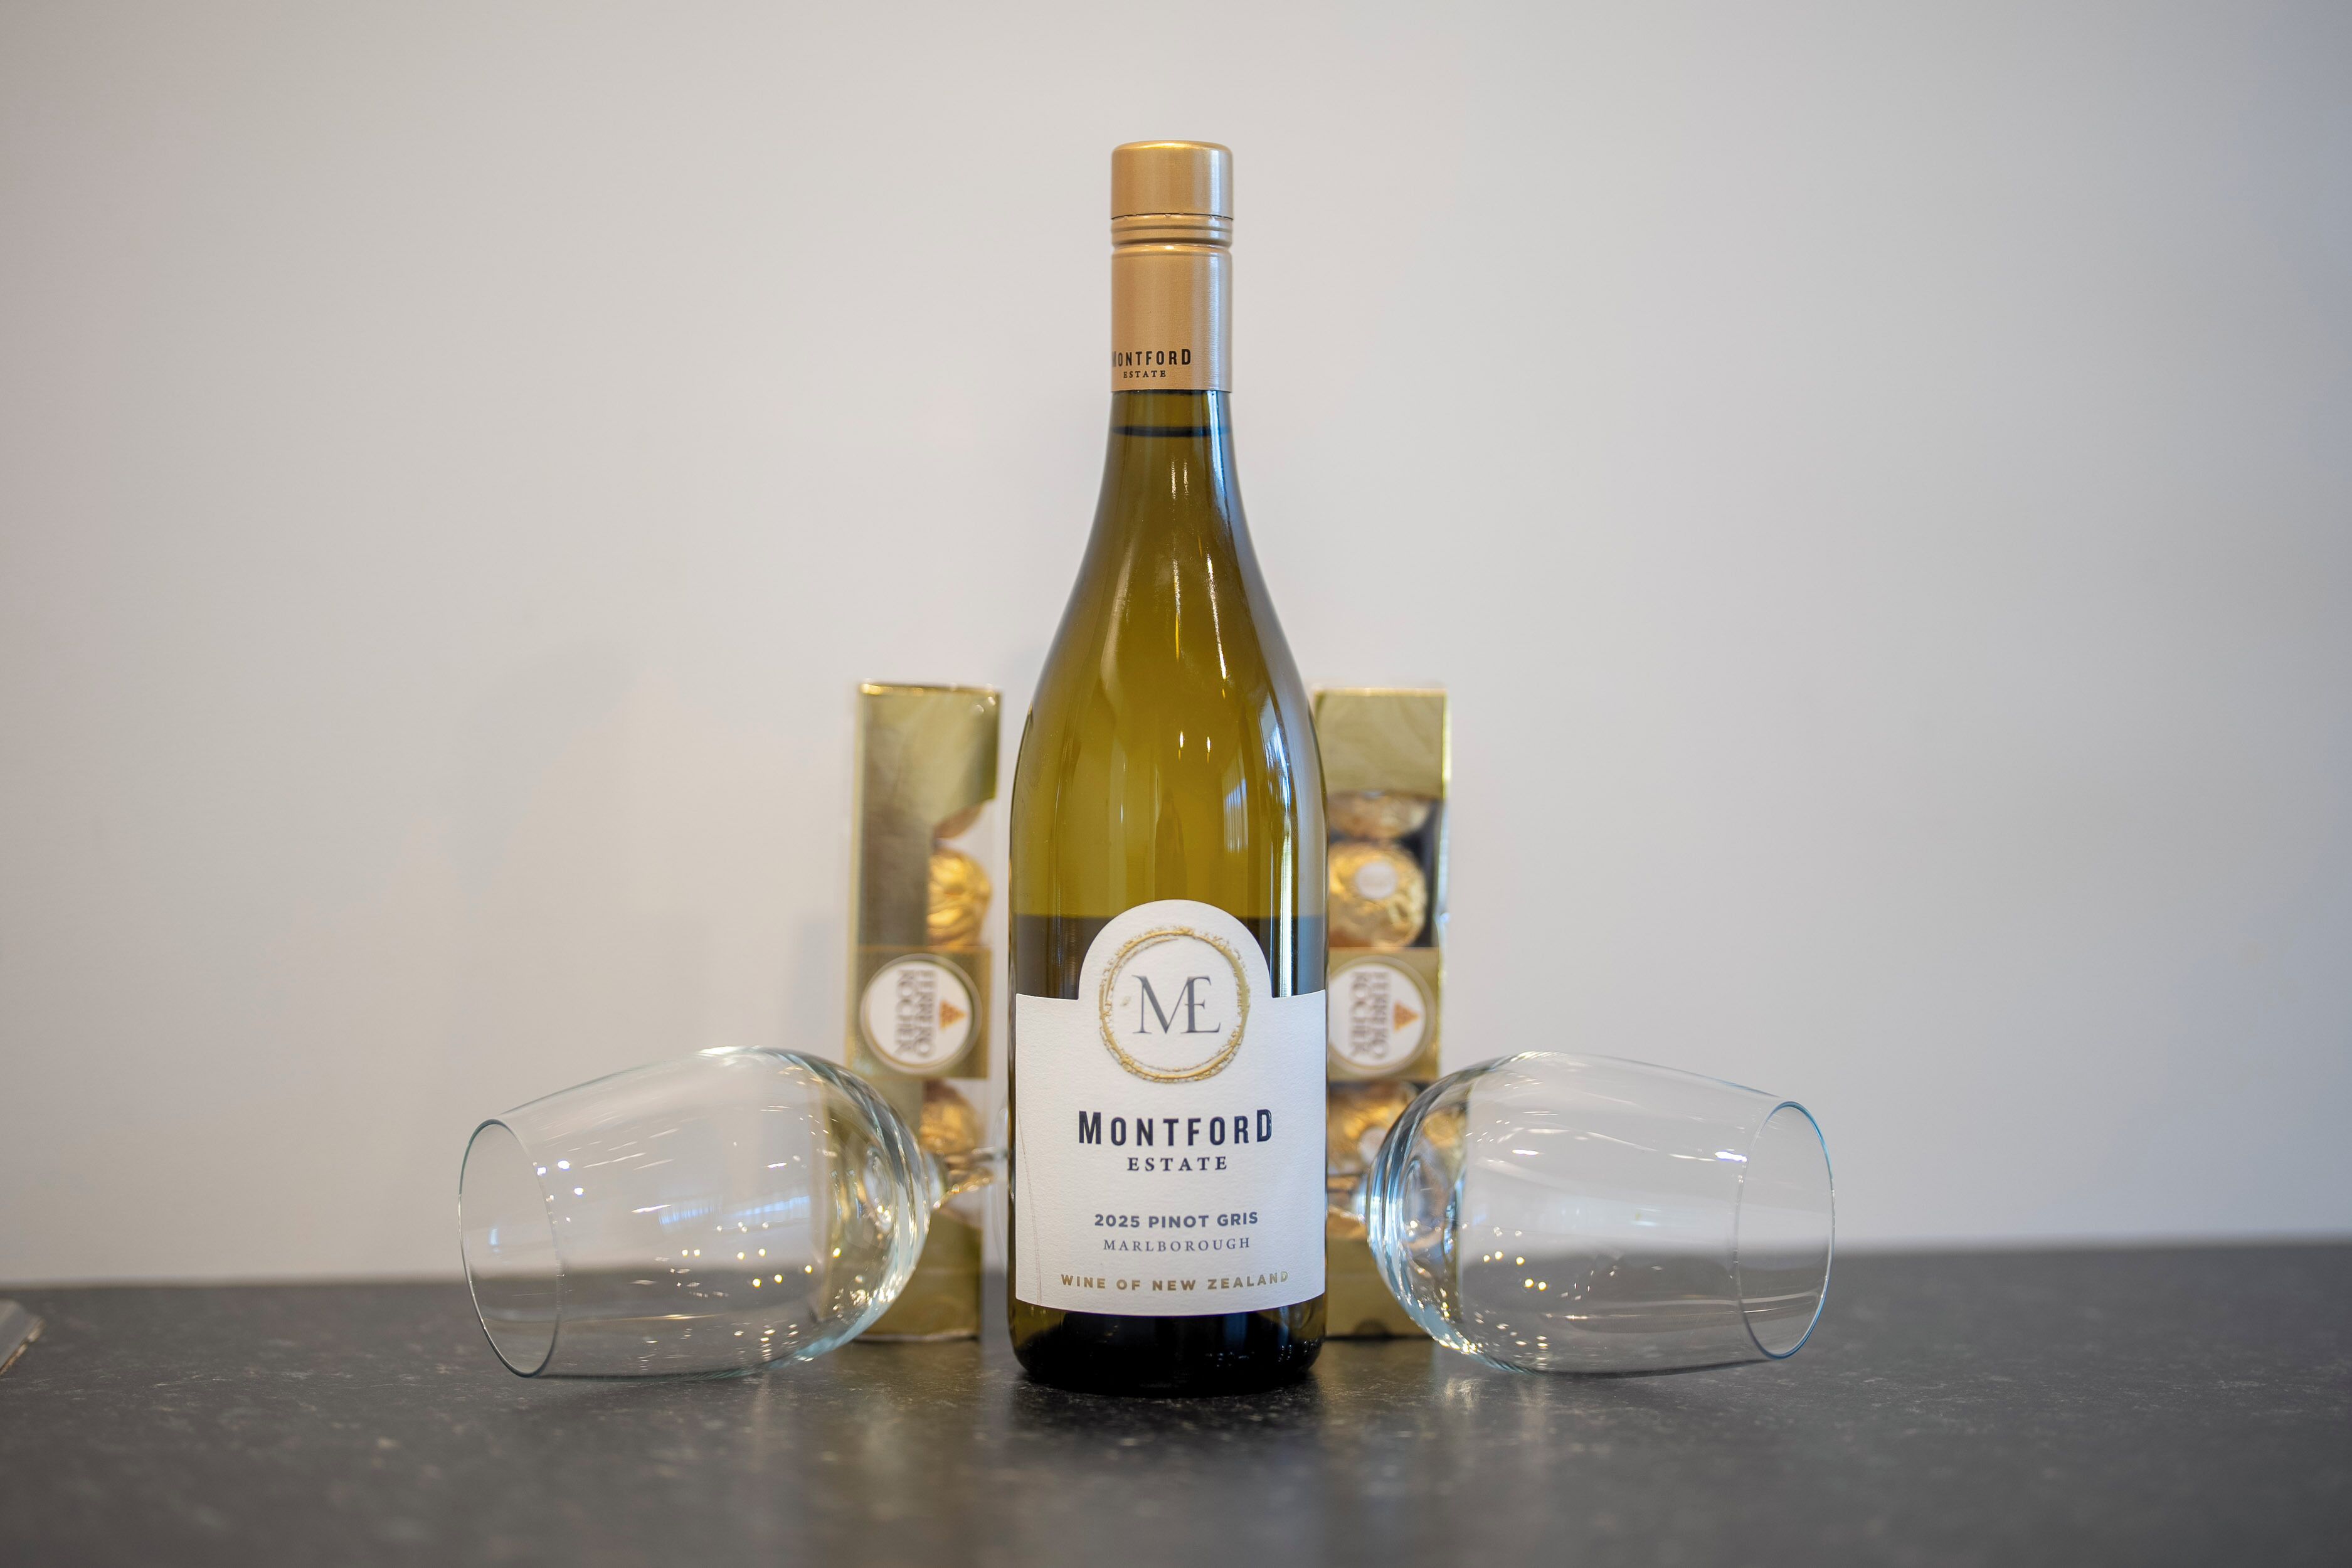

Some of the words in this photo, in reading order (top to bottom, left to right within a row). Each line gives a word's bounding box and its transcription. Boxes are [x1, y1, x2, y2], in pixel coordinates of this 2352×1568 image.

[1123, 370, 1166, 378] ESTATE
[1131, 975, 1221, 1034] ME
[1078, 1109, 1273, 1147] MONTFORD
[1127, 1156, 1227, 1172] ESTATE
[1094, 1214, 1140, 1228] 2025
[1148, 1215, 1209, 1229] PINOT
[1217, 1211, 1259, 1226] GRIS
[1103, 1237, 1251, 1252] MARLBOROUGH
[1061, 1274, 1106, 1290] WINE
[1116, 1279, 1141, 1291] OF
[1152, 1279, 1196, 1291] NEW
[1207, 1271, 1289, 1290] ZEALAND
